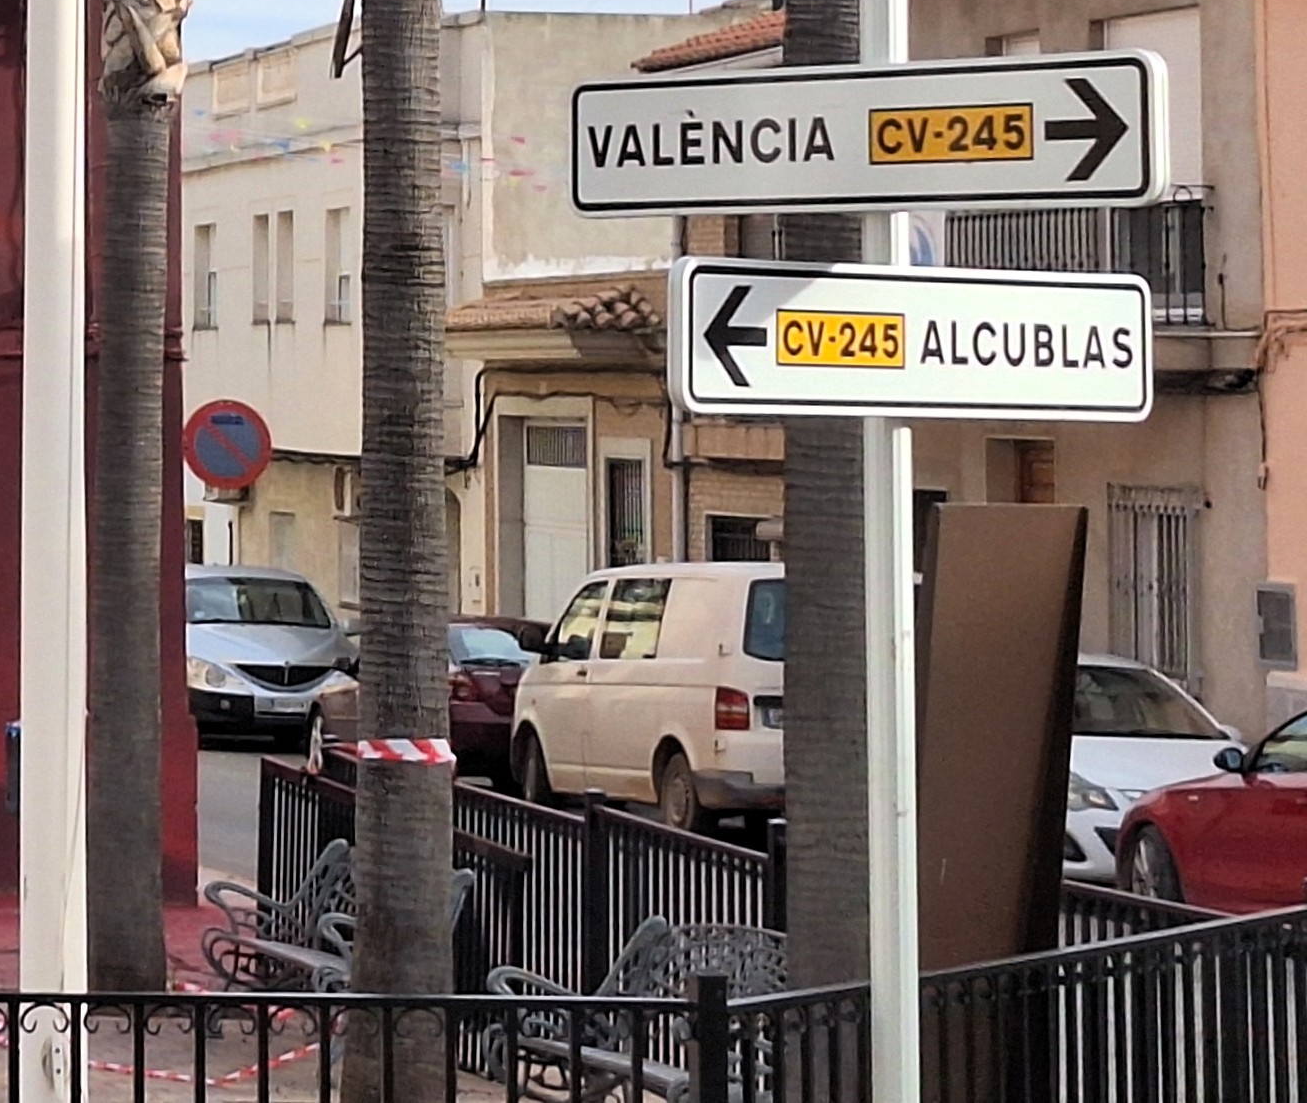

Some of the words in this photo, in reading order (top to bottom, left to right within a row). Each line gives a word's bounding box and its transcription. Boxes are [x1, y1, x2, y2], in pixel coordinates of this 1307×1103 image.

[588, 109, 835, 168] VALÈNCIA
[877, 114, 1025, 154] CV-245
[782, 320, 899, 358] CV-245
[920, 320, 1133, 369] ALCUBLAS
